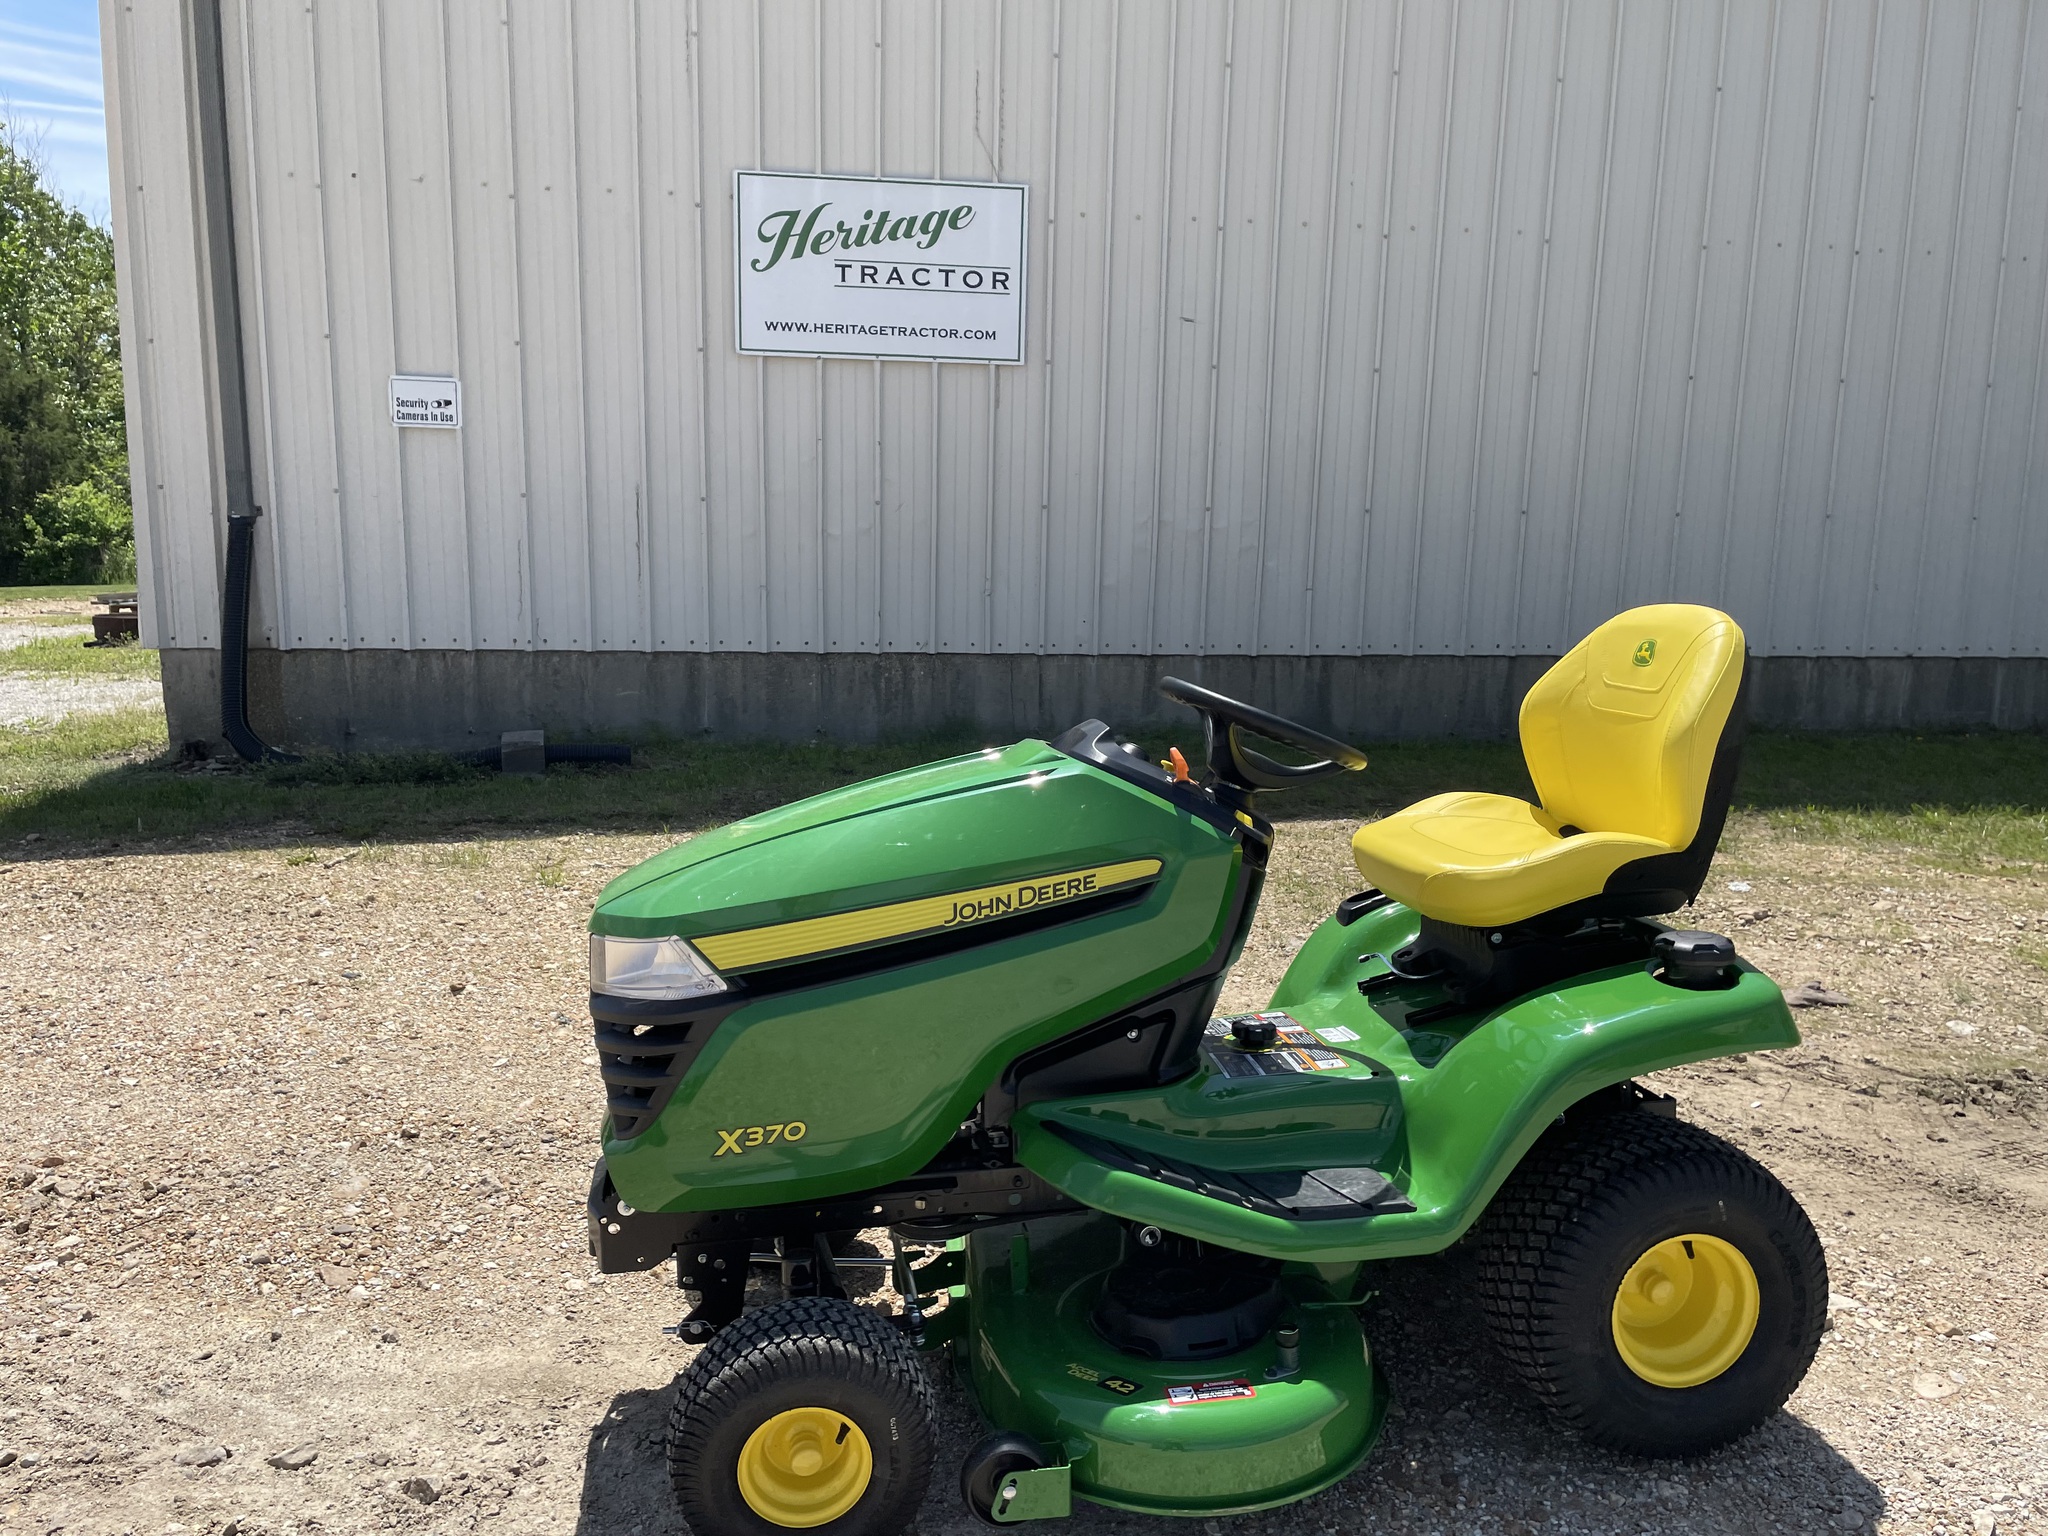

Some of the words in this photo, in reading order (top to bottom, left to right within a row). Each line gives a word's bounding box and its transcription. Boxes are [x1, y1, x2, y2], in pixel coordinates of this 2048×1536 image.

[751, 202, 976, 272] Heritage
[834, 263, 1010, 290] TRACTOR
[765, 320, 997, 341] WWW.HERITAGETRACTOR.COM
[396, 397, 428, 410] Security
[396, 410, 429, 420] Cameras
[431, 411, 438, 421] In
[440, 412, 454, 422] Use
[944, 894, 1012, 925] JOHN
[1018, 874, 1098, 908] DEERE
[713, 1121, 807, 1157] X370
[1067, 1369, 1099, 1382] DEEP
[1105, 1380, 1135, 1394] 42
